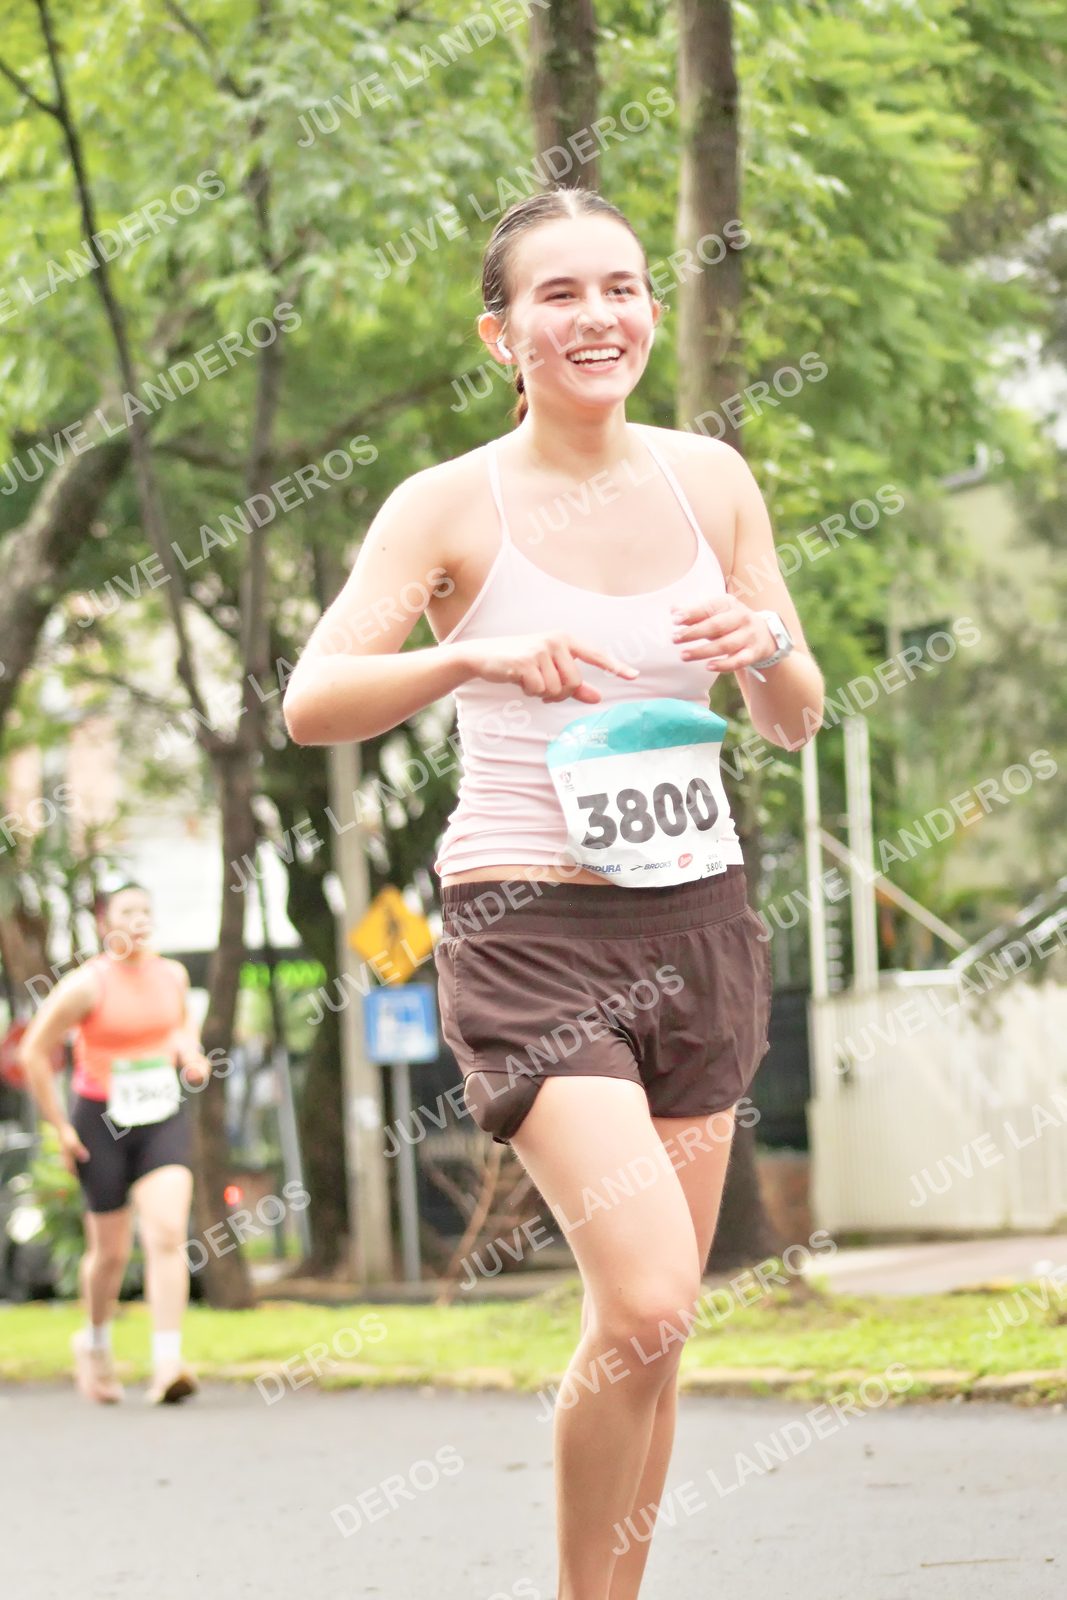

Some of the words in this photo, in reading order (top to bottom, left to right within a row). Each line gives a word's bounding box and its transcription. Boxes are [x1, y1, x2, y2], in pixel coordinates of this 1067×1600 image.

[577, 778, 719, 849] 3800
[644, 861, 671, 870] BROOKS
[706, 861, 722, 872] 3800
